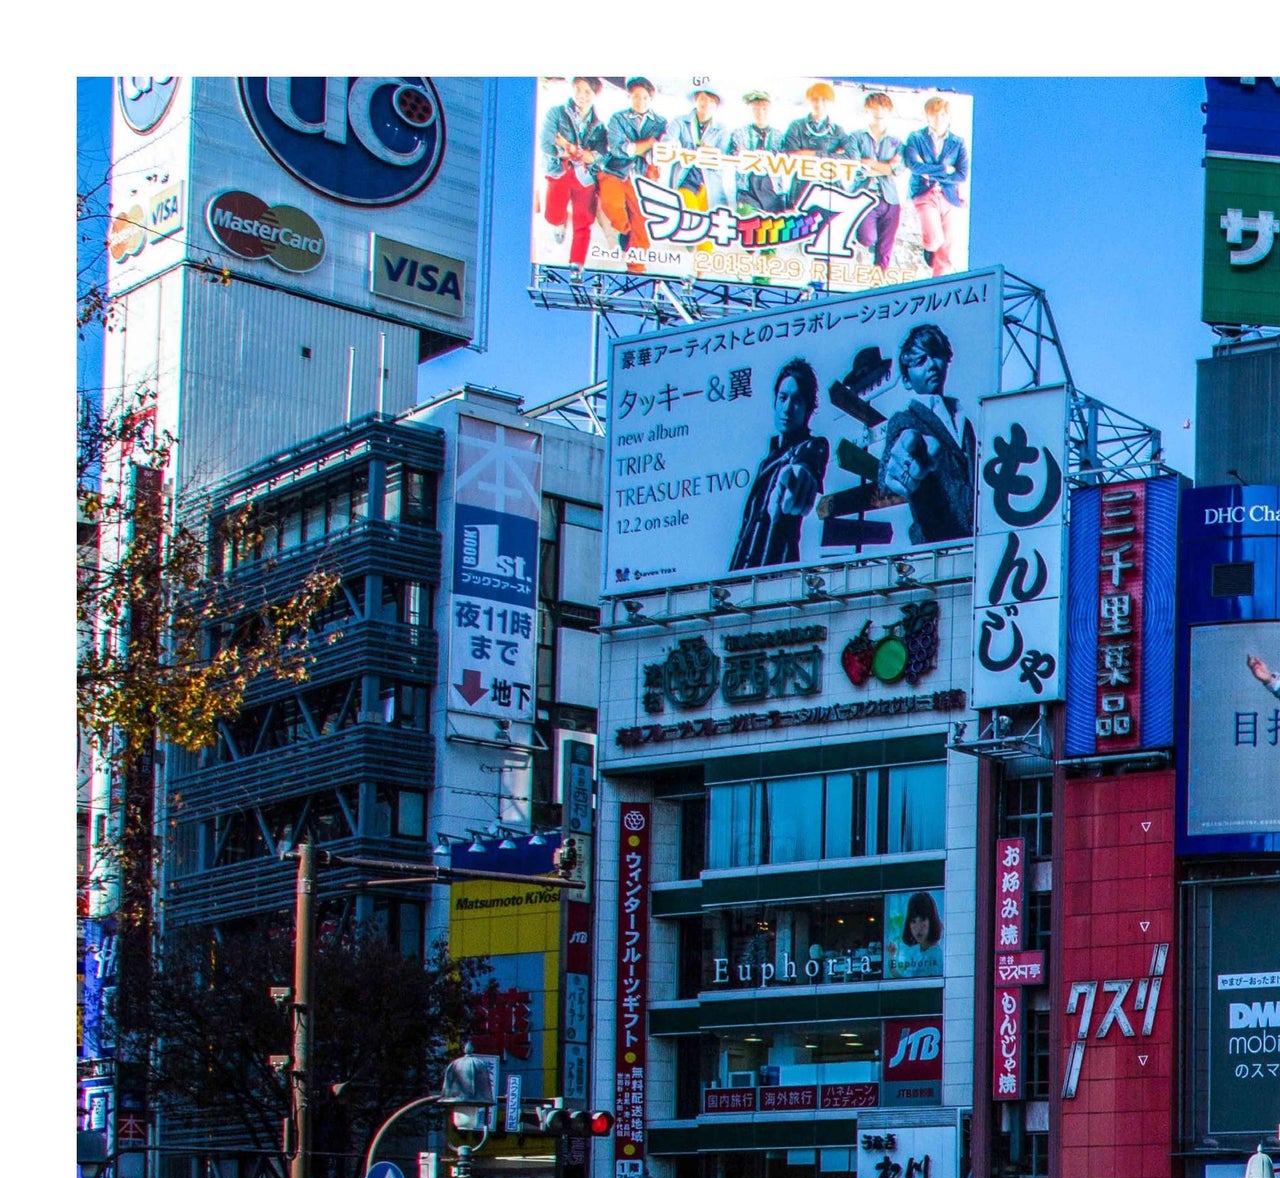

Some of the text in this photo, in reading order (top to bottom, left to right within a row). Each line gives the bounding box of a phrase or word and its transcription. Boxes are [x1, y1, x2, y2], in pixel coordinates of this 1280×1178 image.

[655, 144, 859, 182] ジャニーズWEST
[150, 198, 179, 228] VISA
[213, 207, 323, 255] MasterCard
[592, 246, 681, 265] 2nd ALBUM
[383, 253, 462, 301] VISA
[812, 262, 918, 286] RELEASE
[620, 284, 988, 370] 豪華アーティストとのコラボレーションアルバム!
[617, 367, 753, 419] タッキー&翼
[617, 422, 690, 448] new album
[617, 457, 667, 477] TRIP&
[617, 469, 751, 508] TREASURE TWO
[617, 511, 690, 535] 12.2 on sale
[1204, 507, 1246, 525] DHC
[462, 526, 479, 570] BOOK
[978, 422, 1063, 695] もんじゃ
[460, 572, 533, 595] ブックファースト
[455, 601, 532, 640] 夜11時
[1096, 490, 1137, 737] 三千里薬品
[470, 636, 519, 665] まで
[491, 679, 531, 711] 地下
[456, 893, 524, 911] Matsumoto
[1000, 845, 1020, 945] お好み焼
[569, 931, 589, 944] JTB
[622, 851, 643, 1048] ウィンターフルーツギフト
[713, 953, 874, 988] Euphoria
[1062, 943, 1169, 1099] クスリ
[888, 1026, 942, 1069] JTB
[999, 991, 1017, 1095] もんじゃ焼
[631, 1067, 644, 1143] 無料配送地域
[708, 1094, 755, 1109] 国内旅行
[764, 1089, 813, 1106] 海外旅行
[823, 1094, 876, 1109] ウエディング
[826, 1085, 874, 1096] ハネムーン
[861, 1134, 897, 1153] うなぎ
